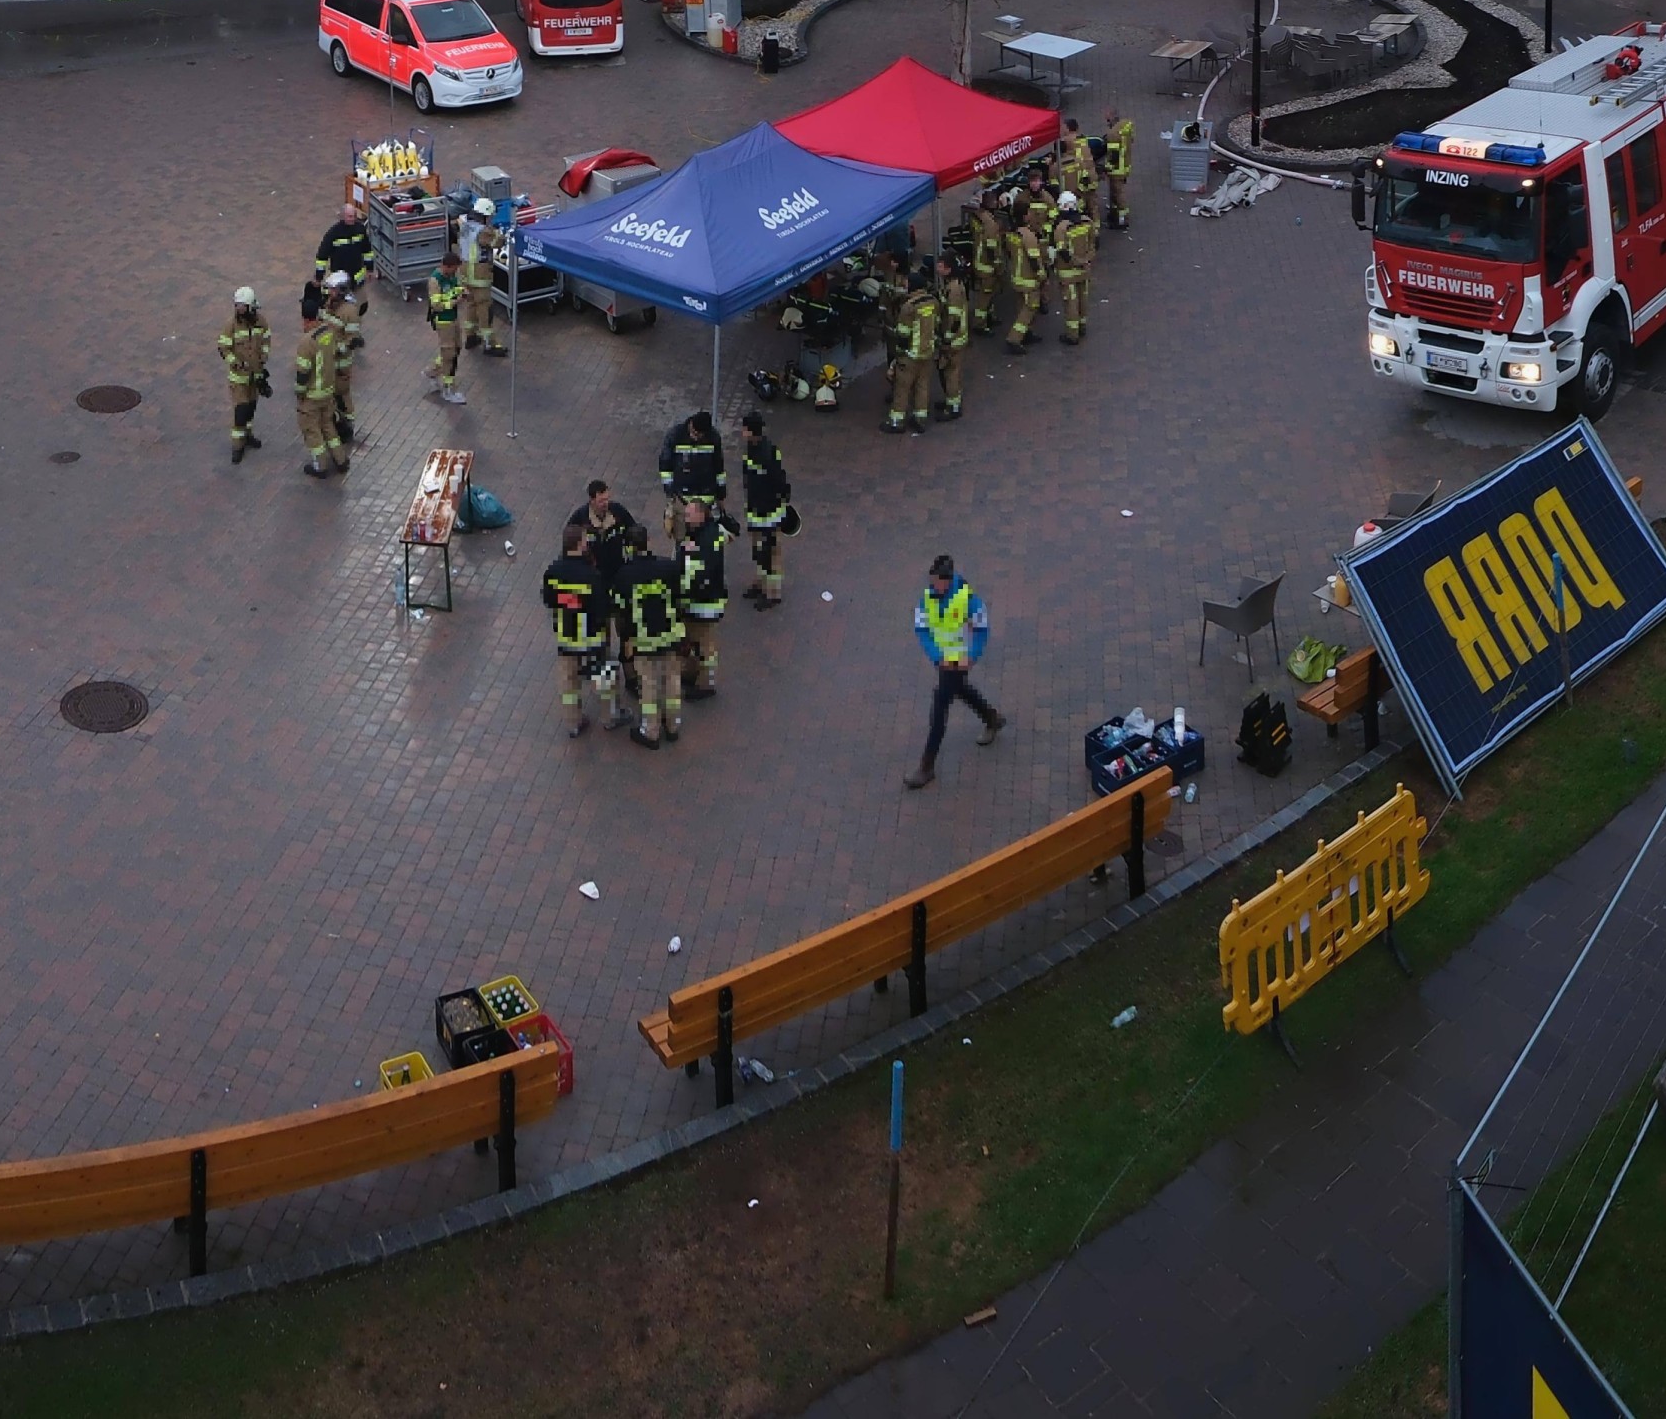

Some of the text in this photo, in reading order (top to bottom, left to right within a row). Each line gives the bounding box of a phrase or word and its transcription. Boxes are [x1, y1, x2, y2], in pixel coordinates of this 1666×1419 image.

[543, 15, 613, 29] FEUERWEHR
[444, 40, 508, 58] FEUERWEHR
[973, 134, 1033, 173] FEUERWEHR
[1462, 146, 1478, 157] 122
[1425, 169, 1469, 188] INZING
[758, 186, 820, 231] Seefeld
[610, 212, 693, 248] Seefeld
[1406, 260, 1434, 273] IVECO
[1398, 269, 1496, 299] FEUERWEHR
